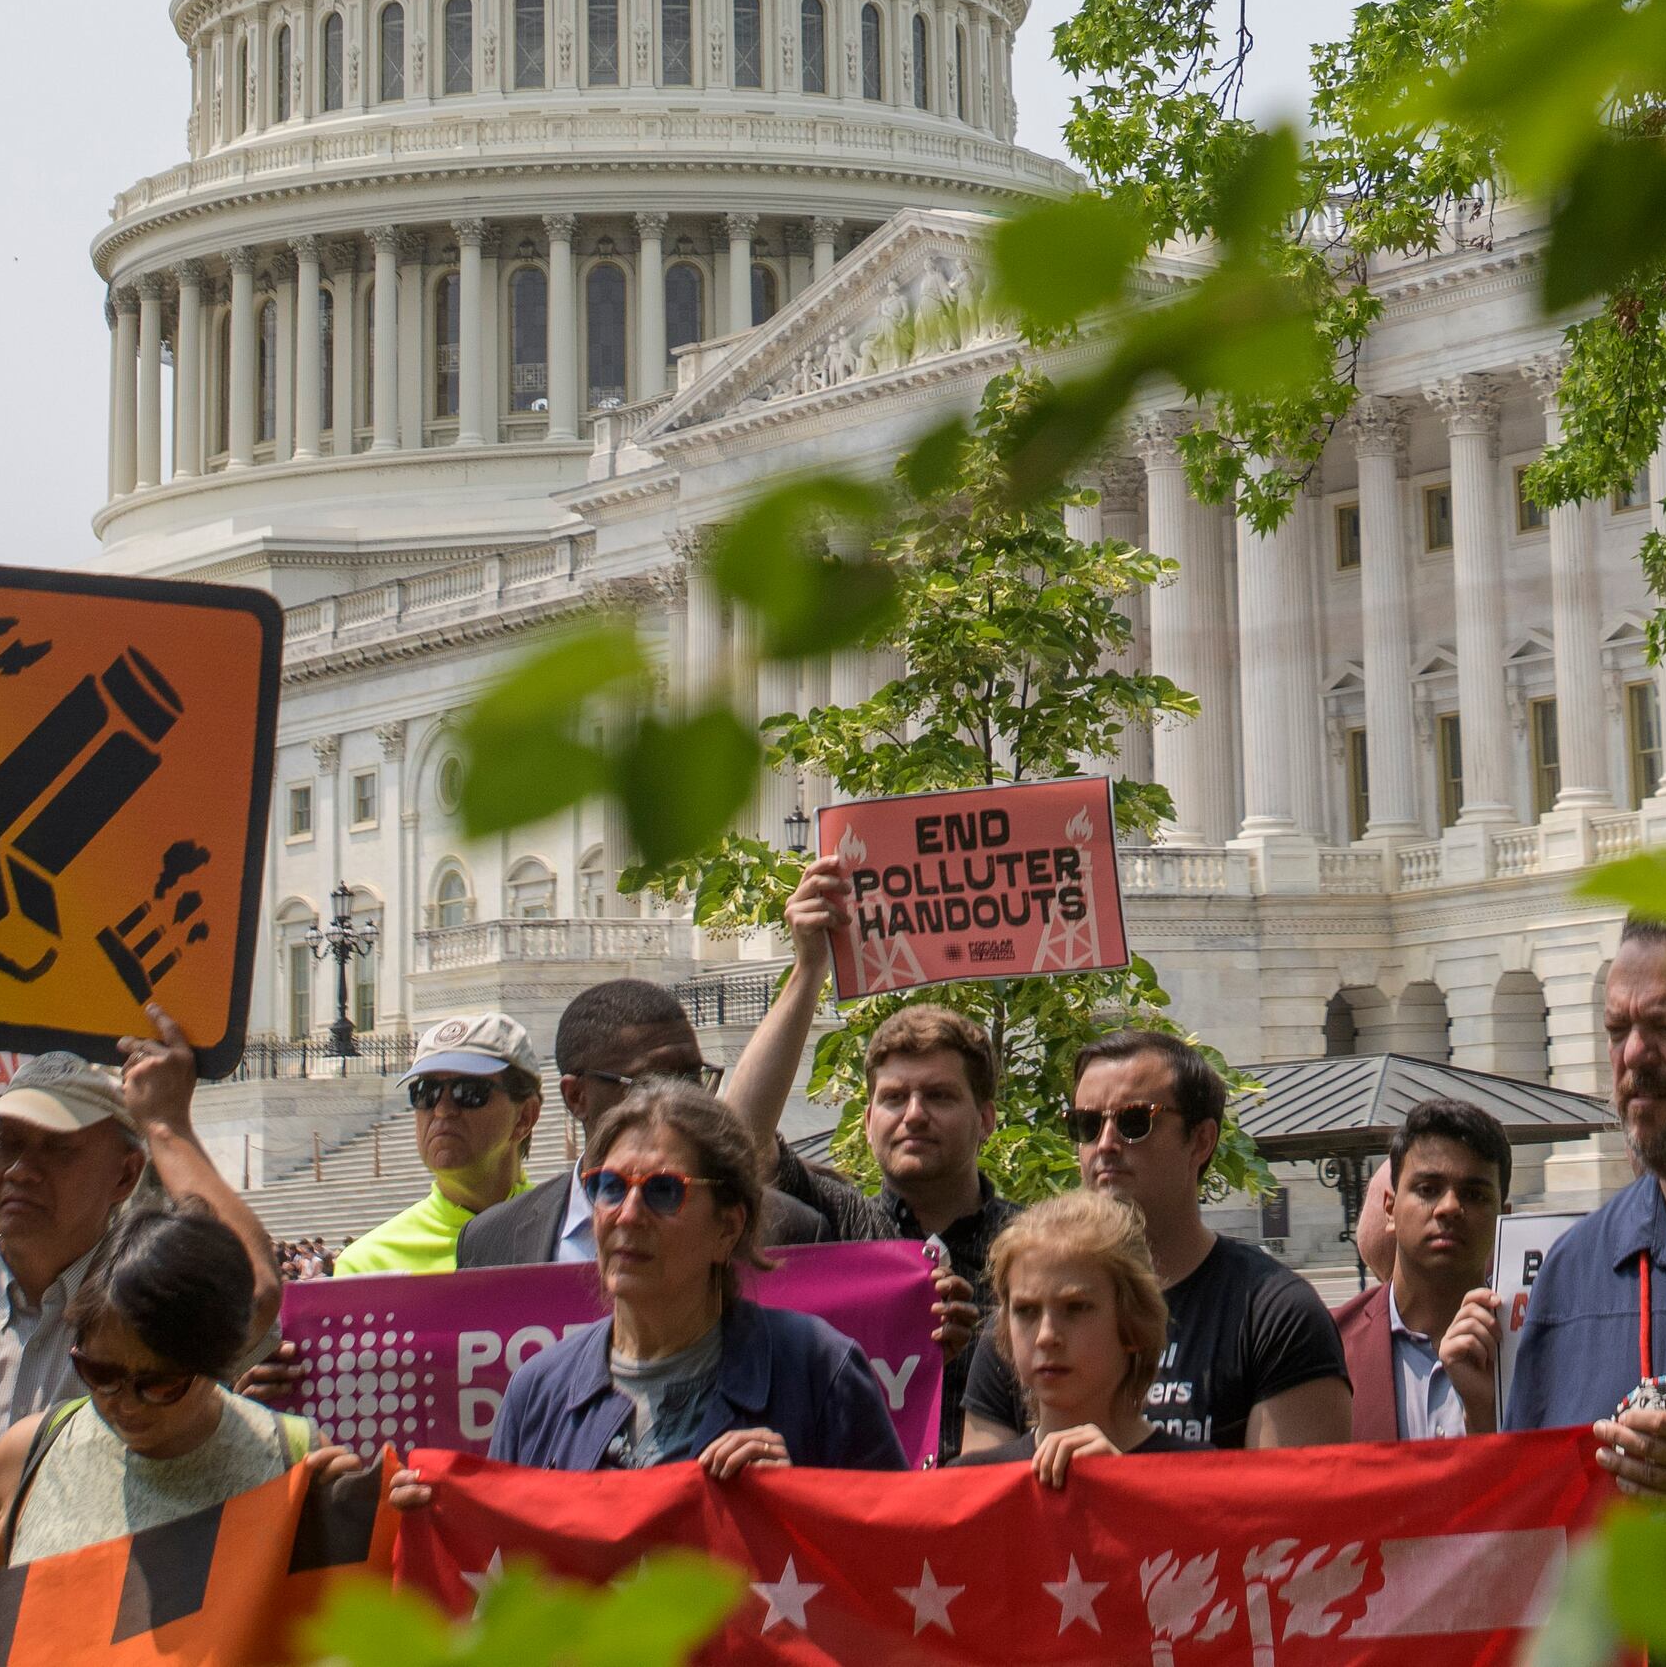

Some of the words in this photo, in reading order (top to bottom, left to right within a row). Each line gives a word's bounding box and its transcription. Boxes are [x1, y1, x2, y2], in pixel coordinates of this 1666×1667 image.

[915, 808, 1011, 855] END
[852, 846, 1082, 901] POLLUTER
[857, 886, 1087, 941] HANDOUTS
